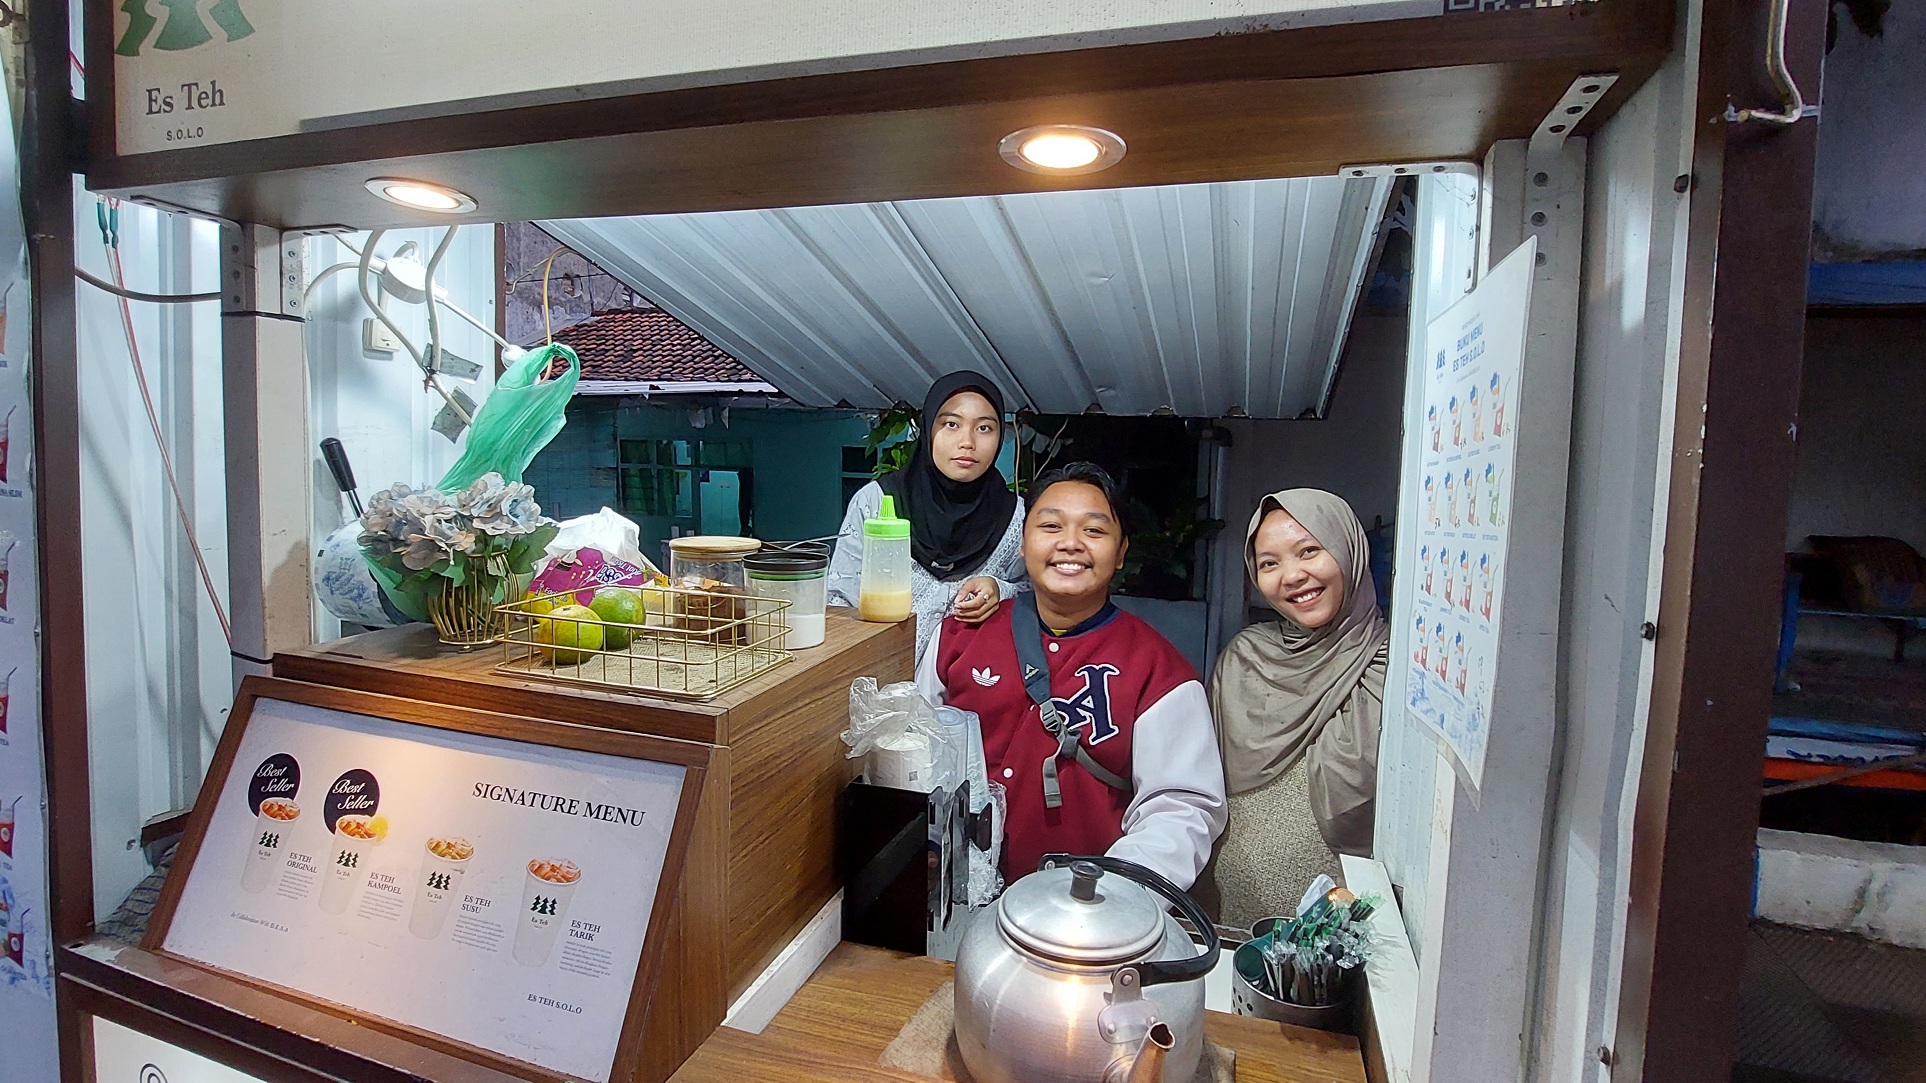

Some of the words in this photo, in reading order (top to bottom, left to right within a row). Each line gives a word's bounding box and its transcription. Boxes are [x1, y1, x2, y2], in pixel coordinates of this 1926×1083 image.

[146, 88, 174, 115] Es
[181, 80, 225, 110] Teh
[166, 126, 204, 141] S.O.L.O
[257, 763, 288, 778] Best
[261, 778, 295, 793] Seller
[332, 779, 366, 794] Best
[337, 794, 375, 810] Seller
[472, 782, 580, 816] SIGNATURE
[582, 801, 646, 827] MENU
[289, 852, 297, 861] ES
[298, 854, 312, 864] TEH
[286, 860, 318, 874] ORIGINAL
[370, 872, 379, 882] ES
[380, 874, 396, 885] TEH
[367, 880, 402, 895] KAMPOEL
[464, 894, 473, 903] ES
[474, 897, 491, 907] TEH
[461, 903, 482, 914] SUSU
[571, 919, 581, 929] ES
[582, 922, 601, 934] TEH
[569, 928, 595, 942] TARIK
[527, 993, 537, 1002] ES
[538, 996, 555, 1008] TEH
[555, 1000, 583, 1015] S.O.L.O
